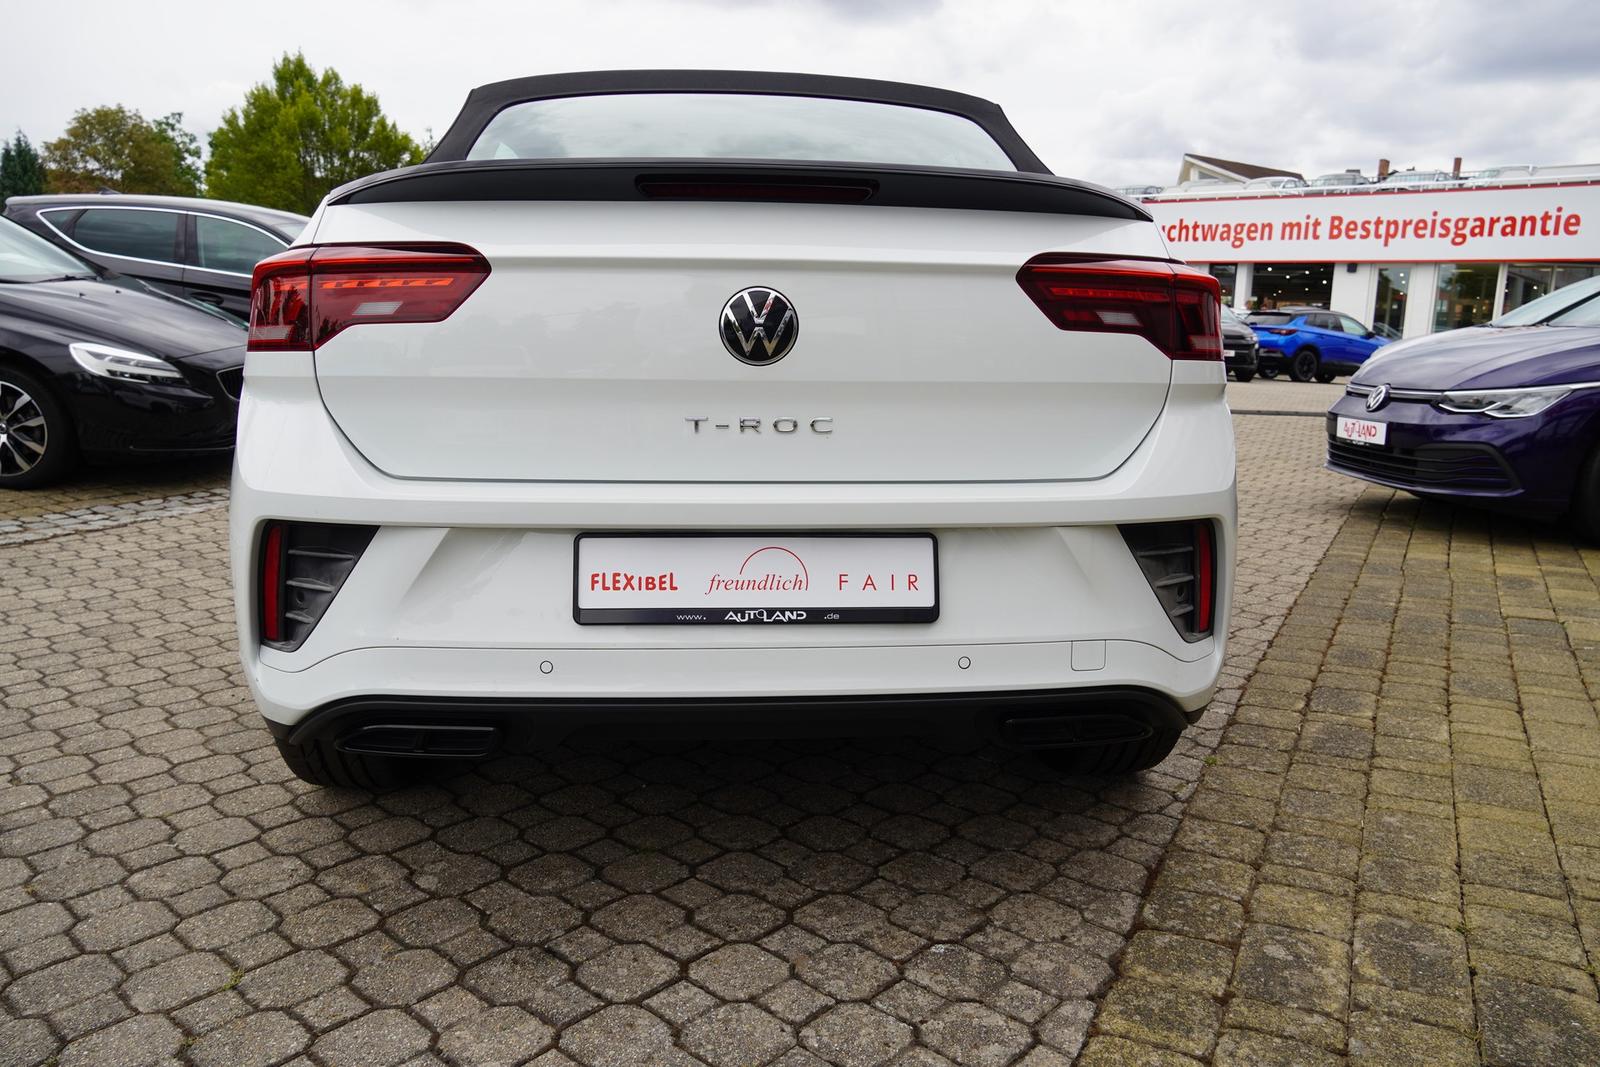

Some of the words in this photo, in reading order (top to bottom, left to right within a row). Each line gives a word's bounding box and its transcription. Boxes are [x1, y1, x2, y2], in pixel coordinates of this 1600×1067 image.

[1161, 217, 1274, 248] chtwagen
[1280, 213, 1322, 241] mit
[1328, 206, 1582, 247] Bestpreisgarantie
[685, 416, 834, 435] T-ROC
[590, 572, 679, 592] FLEXIBEL
[705, 572, 806, 596] freundlich
[676, 613, 707, 621] www.
[823, 612, 840, 621] .de
